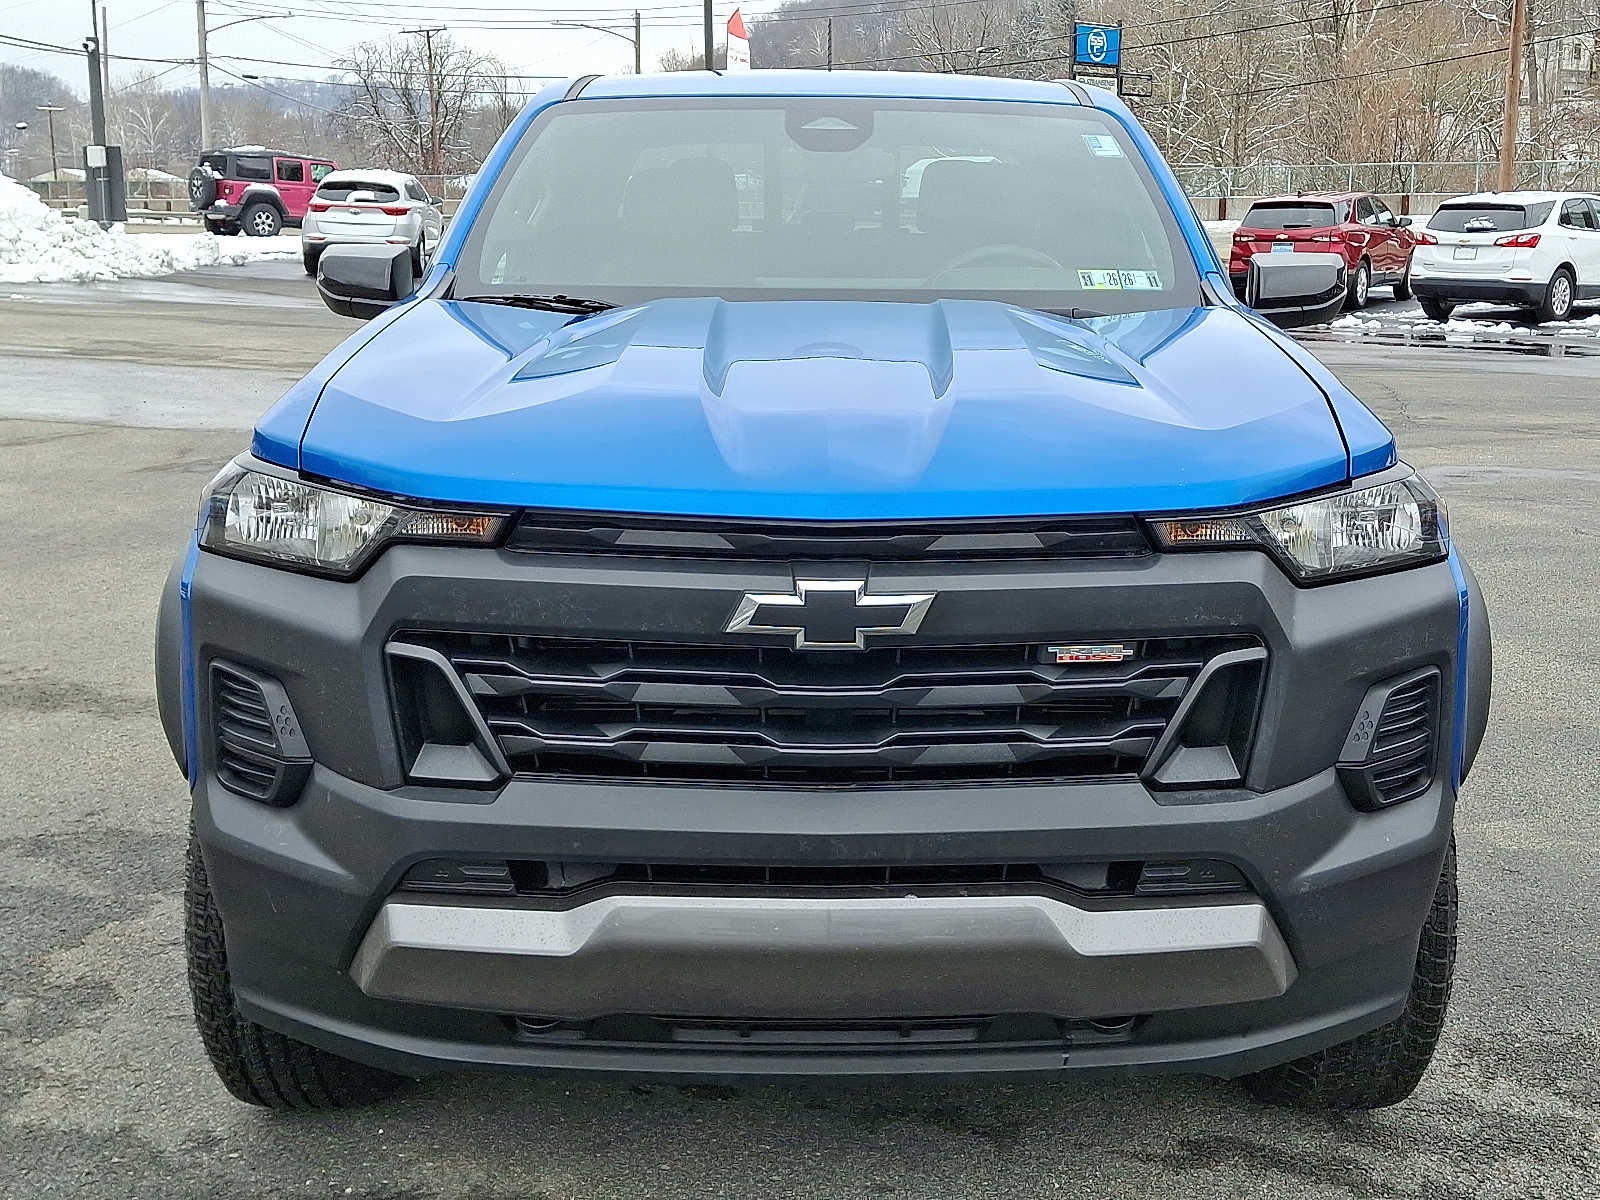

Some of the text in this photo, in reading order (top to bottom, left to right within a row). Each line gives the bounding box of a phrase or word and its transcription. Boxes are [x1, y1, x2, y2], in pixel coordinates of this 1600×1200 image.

[1107, 272, 1119, 286] 26
[1121, 272, 1134, 286] 26
[1057, 654, 1124, 663] BOSS
